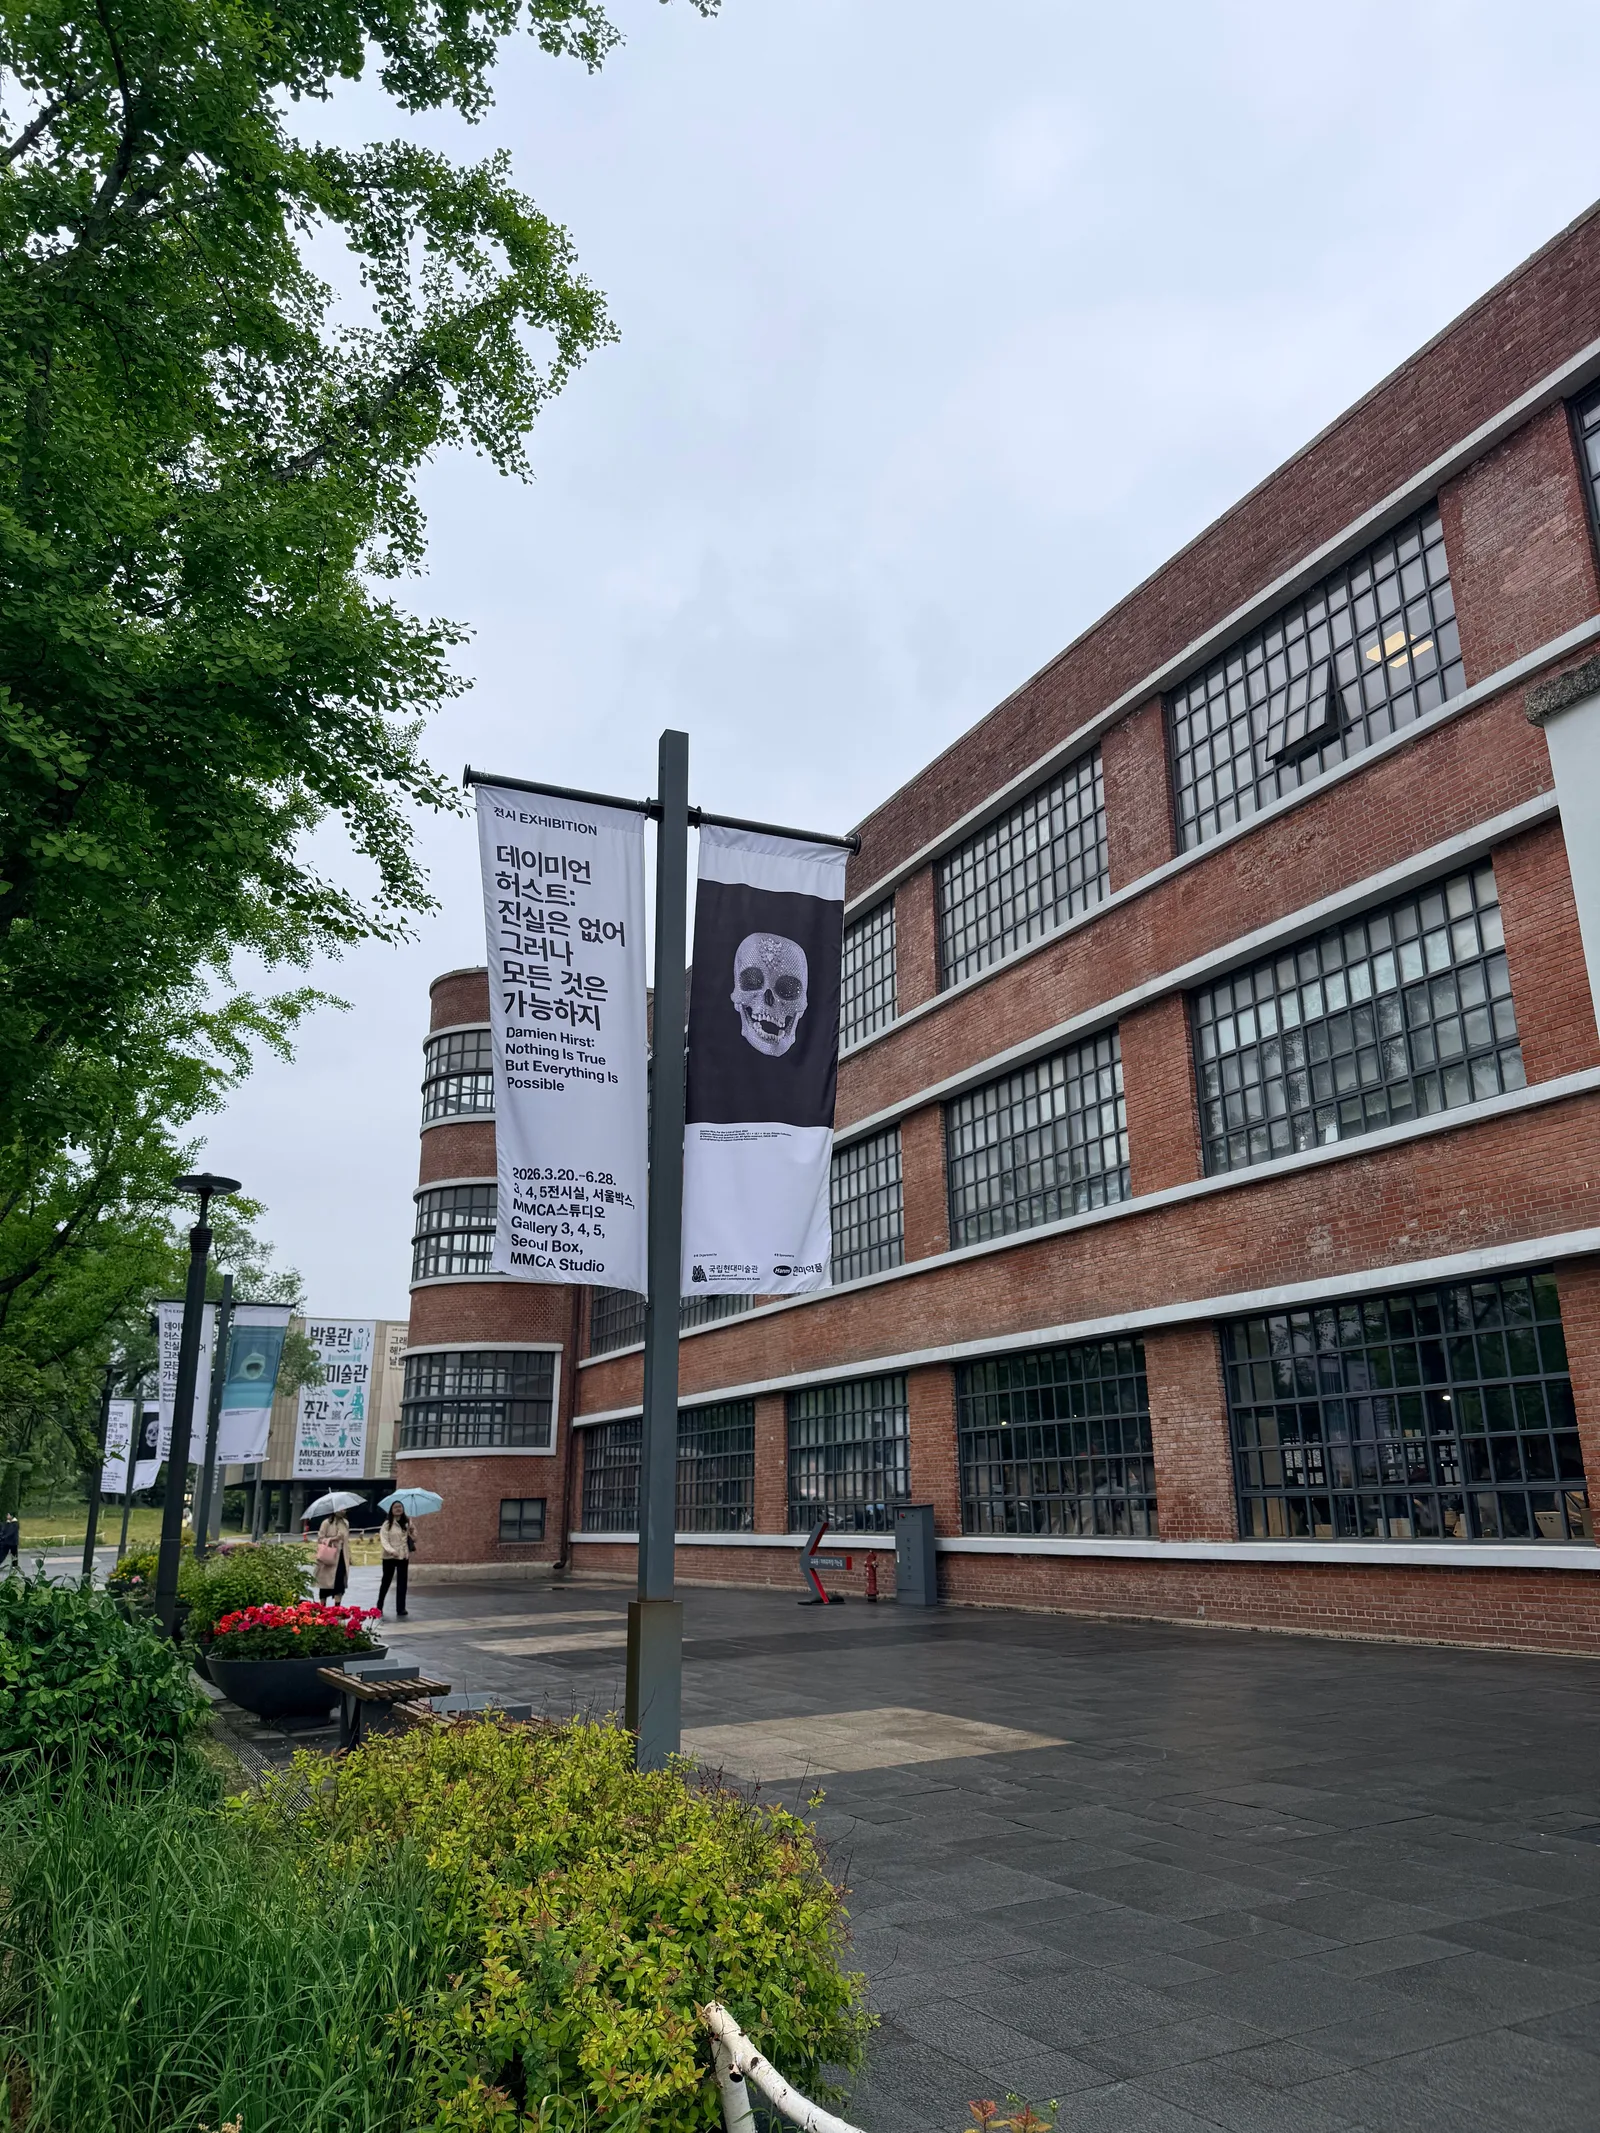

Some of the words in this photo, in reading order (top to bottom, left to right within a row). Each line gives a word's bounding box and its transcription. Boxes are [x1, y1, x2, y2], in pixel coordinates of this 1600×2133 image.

[494, 807, 516, 821] 전시
[520, 812, 598, 836] EXHIBITION
[496, 845, 591, 885] 데이미언
[495, 871, 576, 906] 허스트:
[498, 900, 570, 936] 진실은
[579, 917, 625, 947] 없어
[500, 930, 574, 966] 그러나
[502, 960, 552, 990] 모든
[561, 971, 608, 1002] 것은
[504, 990, 601, 1030] 가능하지
[506, 1027, 556, 1042] Damien
[560, 1032, 594, 1047] Hirst:
[506, 1043, 559, 1060] Nothing
[563, 1049, 574, 1060] Is
[576, 1051, 606, 1065] True
[506, 1060, 529, 1071] But
[533, 1061, 604, 1083] Everything
[608, 1072, 619, 1083] Is
[507, 1077, 565, 1091] Possible
[514, 1183, 522, 1197] 3,
[526, 1186, 537, 1200] 4,
[539, 1185, 589, 1201] 5전시실,
[593, 1188, 635, 1209] 서울박스,
[513, 1198, 606, 1218] MMCA스튜디오
[511, 1216, 558, 1237] Gallery
[561, 1222, 574, 1236] 3,
[578, 1223, 590, 1237] 4,
[593, 1224, 605, 1238] 5,
[511, 1234, 548, 1252] Seoul
[552, 1240, 583, 1255] Box,
[510, 1252, 556, 1269] MMCA
[559, 1258, 605, 1272] Studio
[709, 1264, 759, 1274] 국립현대미술관
[310, 1327, 353, 1346] 박물관
[327, 1365, 368, 1384] 미술관
[304, 1400, 329, 1420] 주간
